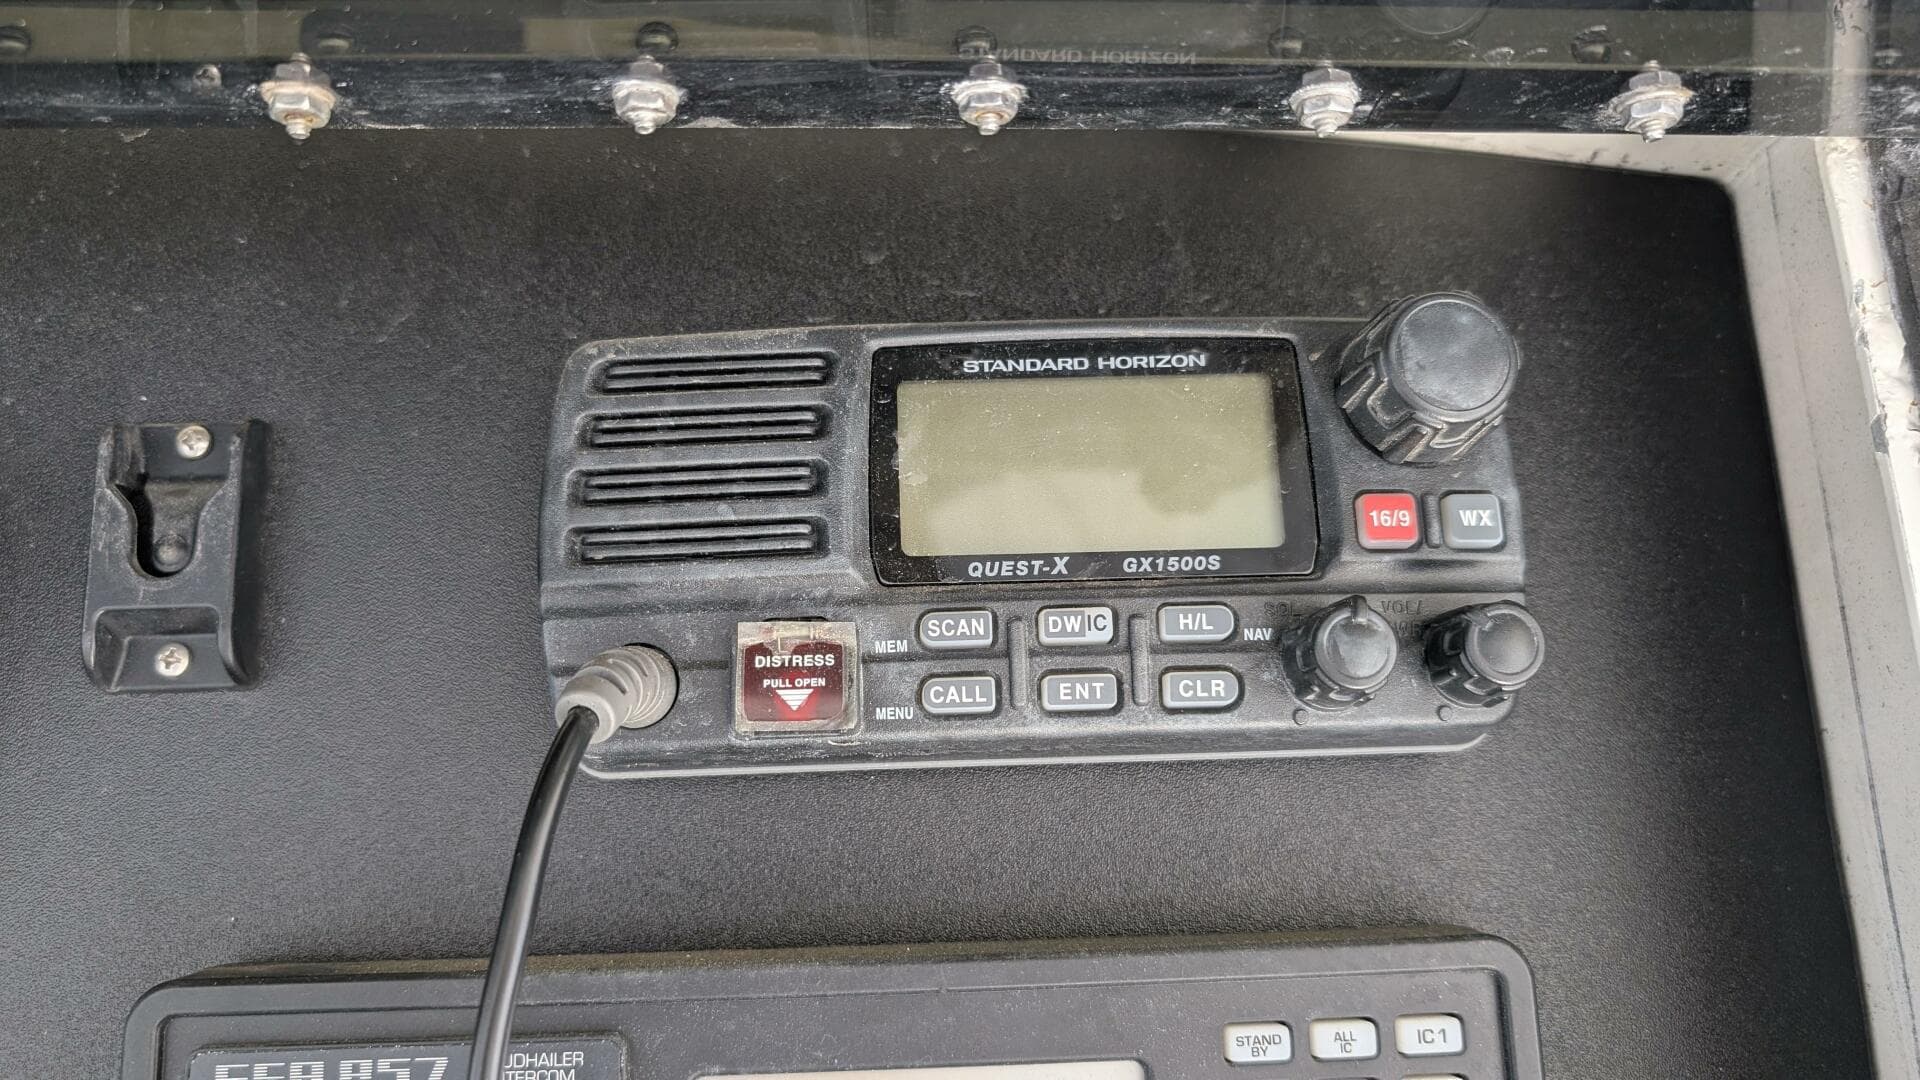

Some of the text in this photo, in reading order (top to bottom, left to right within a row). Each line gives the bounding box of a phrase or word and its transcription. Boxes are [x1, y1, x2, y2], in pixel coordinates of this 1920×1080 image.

[963, 354, 1206, 373] STANDARD HORIZON
[1368, 509, 1411, 527] 16/9
[1458, 509, 1494, 527] WX
[967, 556, 1070, 578] QUEST-X
[1122, 554, 1222, 573] GX1500S
[926, 618, 986, 637] SCAN
[1048, 613, 1108, 633] DW IC
[1178, 612, 1214, 631] H/L
[1243, 627, 1273, 641] NAV
[874, 639, 908, 654] MEM
[754, 653, 835, 669] DISTRESS
[762, 676, 826, 688] PULL OPEN
[1058, 681, 1105, 700] ENT
[1178, 679, 1226, 698] CLR
[929, 684, 988, 704] CALL
[875, 706, 914, 721] MENU
[1235, 1033, 1282, 1047] STAND
[1333, 1030, 1357, 1043] ALL
[1250, 1046, 1269, 1058] BY
[1339, 1043, 1353, 1054] IC
